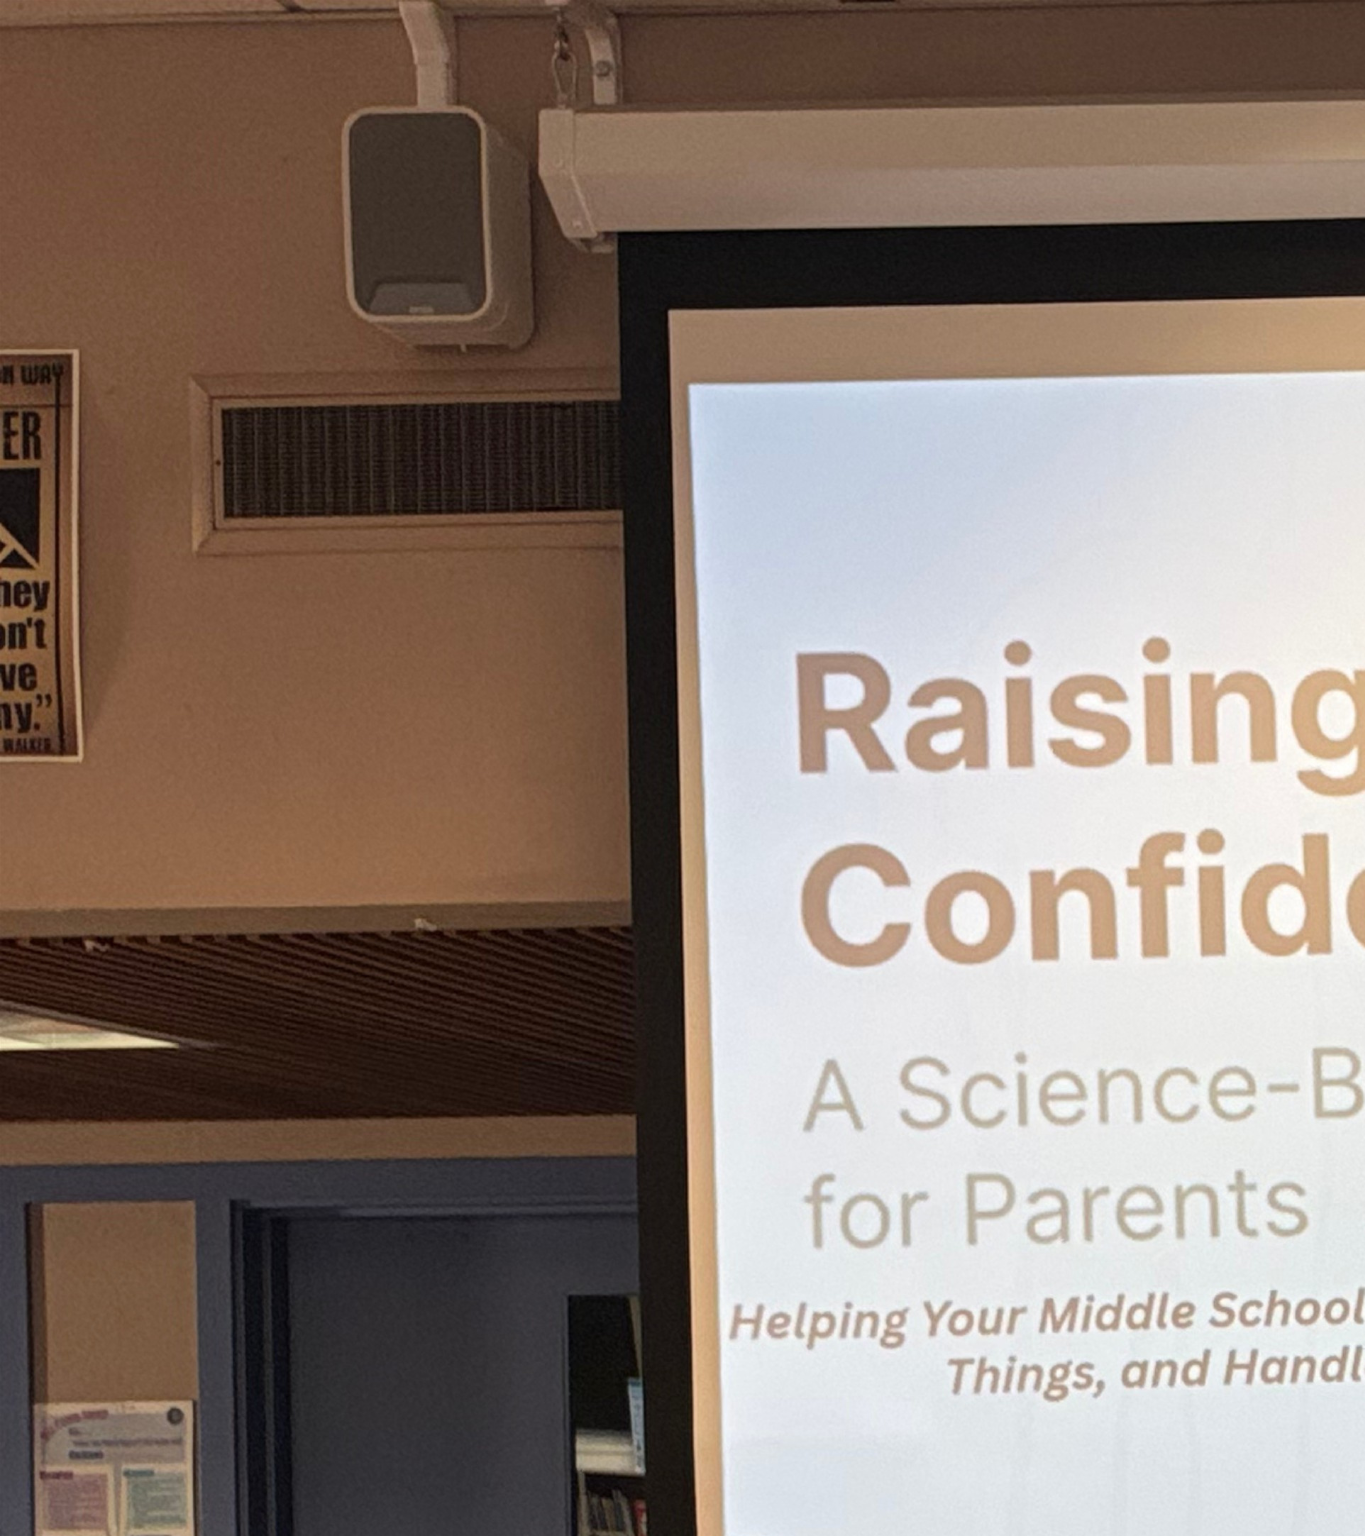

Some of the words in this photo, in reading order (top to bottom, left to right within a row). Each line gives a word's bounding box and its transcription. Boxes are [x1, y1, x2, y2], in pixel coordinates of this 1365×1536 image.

[803, 1059, 864, 1132] A
[804, 1173, 929, 1249] for
[966, 1170, 1308, 1246] Parents
[729, 1302, 909, 1346] Helping
[924, 1301, 1027, 1337] Your
[1039, 1292, 1195, 1333] Middle
[948, 1356, 1105, 1402] Things,
[1121, 1349, 1211, 1388] and
